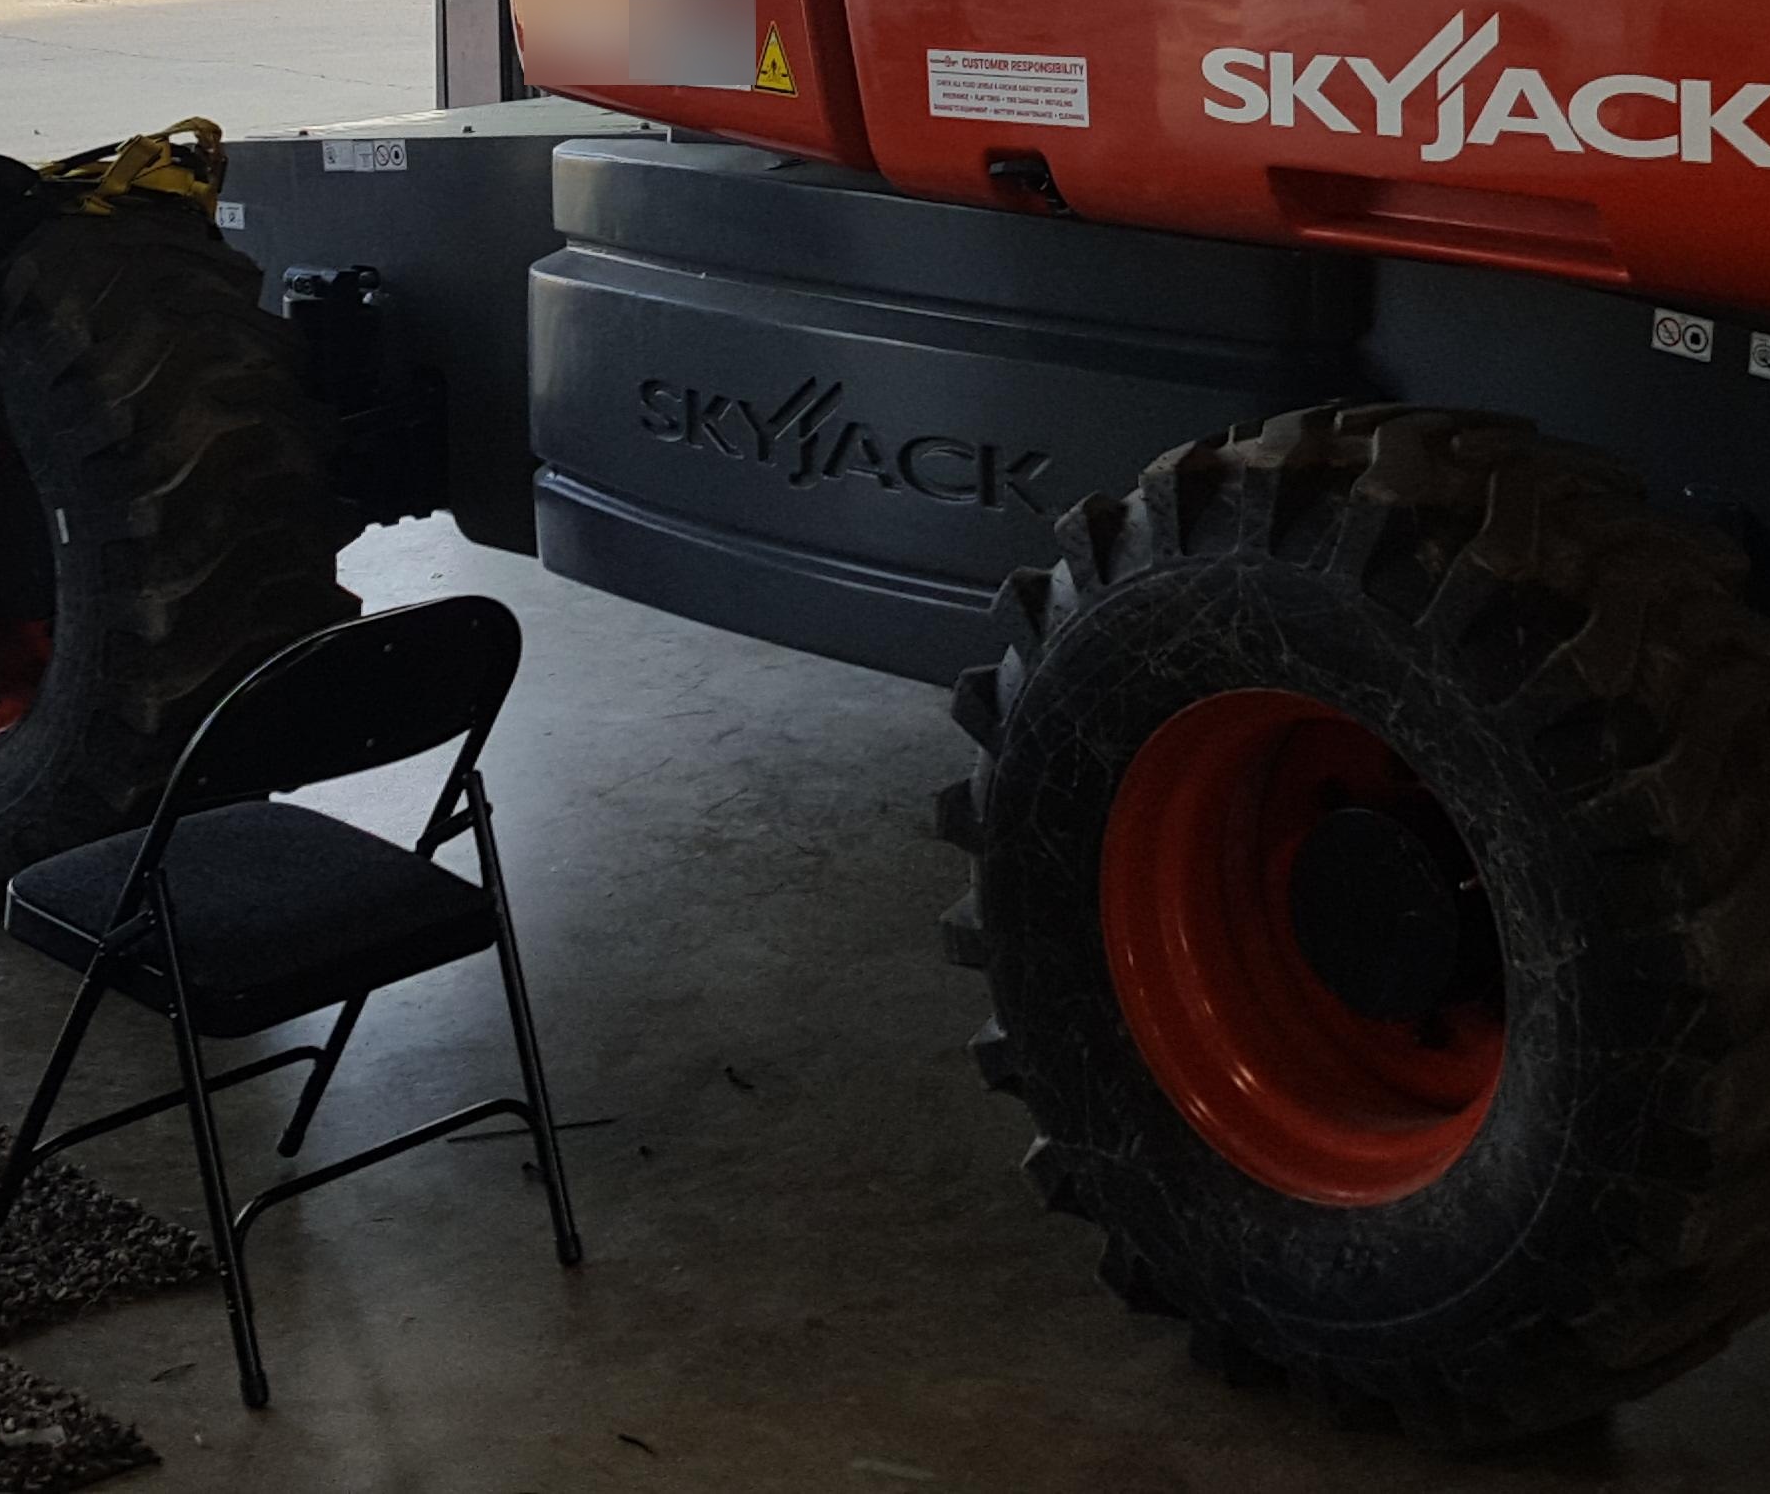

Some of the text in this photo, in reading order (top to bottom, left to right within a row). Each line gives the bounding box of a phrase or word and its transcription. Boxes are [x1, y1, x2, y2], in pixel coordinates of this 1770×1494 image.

[961, 57, 1085, 76] CUSTOMER RESPONSIBILITY
[638, 376, 1053, 516] SKYJACK
